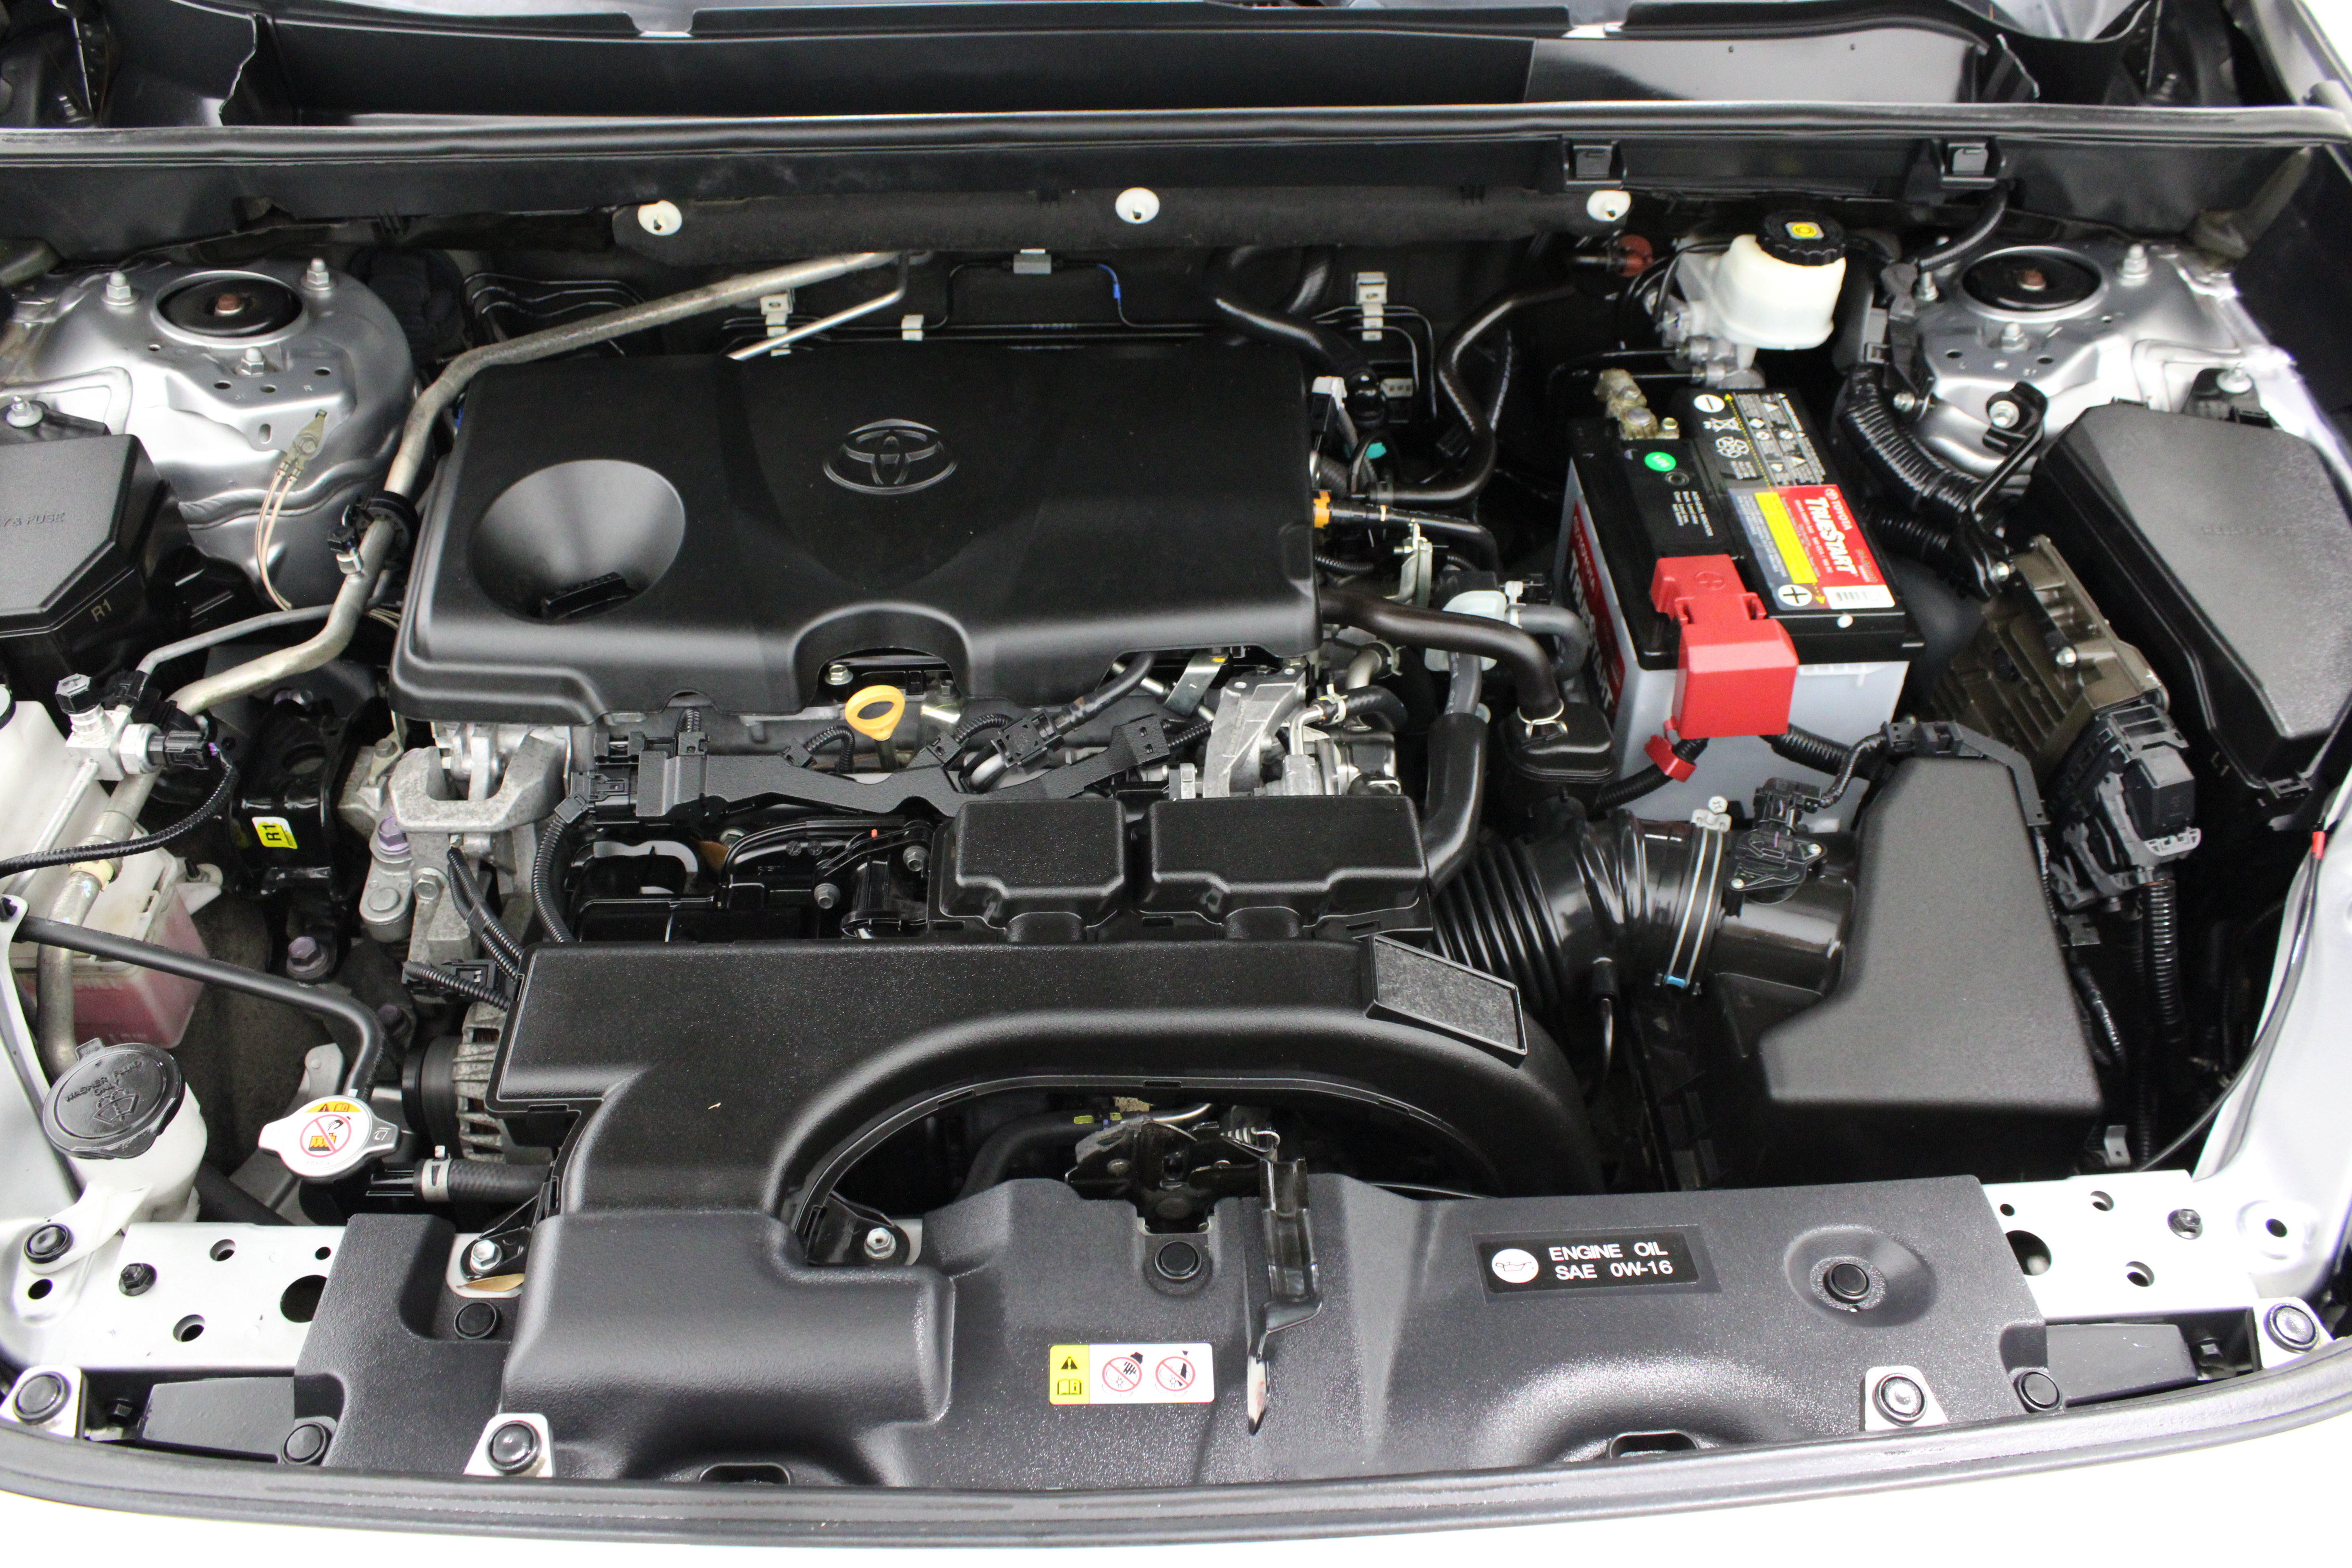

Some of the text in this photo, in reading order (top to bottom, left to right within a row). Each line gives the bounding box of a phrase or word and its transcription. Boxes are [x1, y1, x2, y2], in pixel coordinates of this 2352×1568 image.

[26, 512, 65, 525] FUSE
[1831, 500, 1853, 530] TOYOTA
[91, 599, 112, 622] R1
[262, 824, 282, 841] R1
[65, 1076, 108, 1102] WASHER
[1548, 1242, 1668, 1261] ENGINE OIL
[1555, 1260, 1674, 1281] SAE 0W-16
